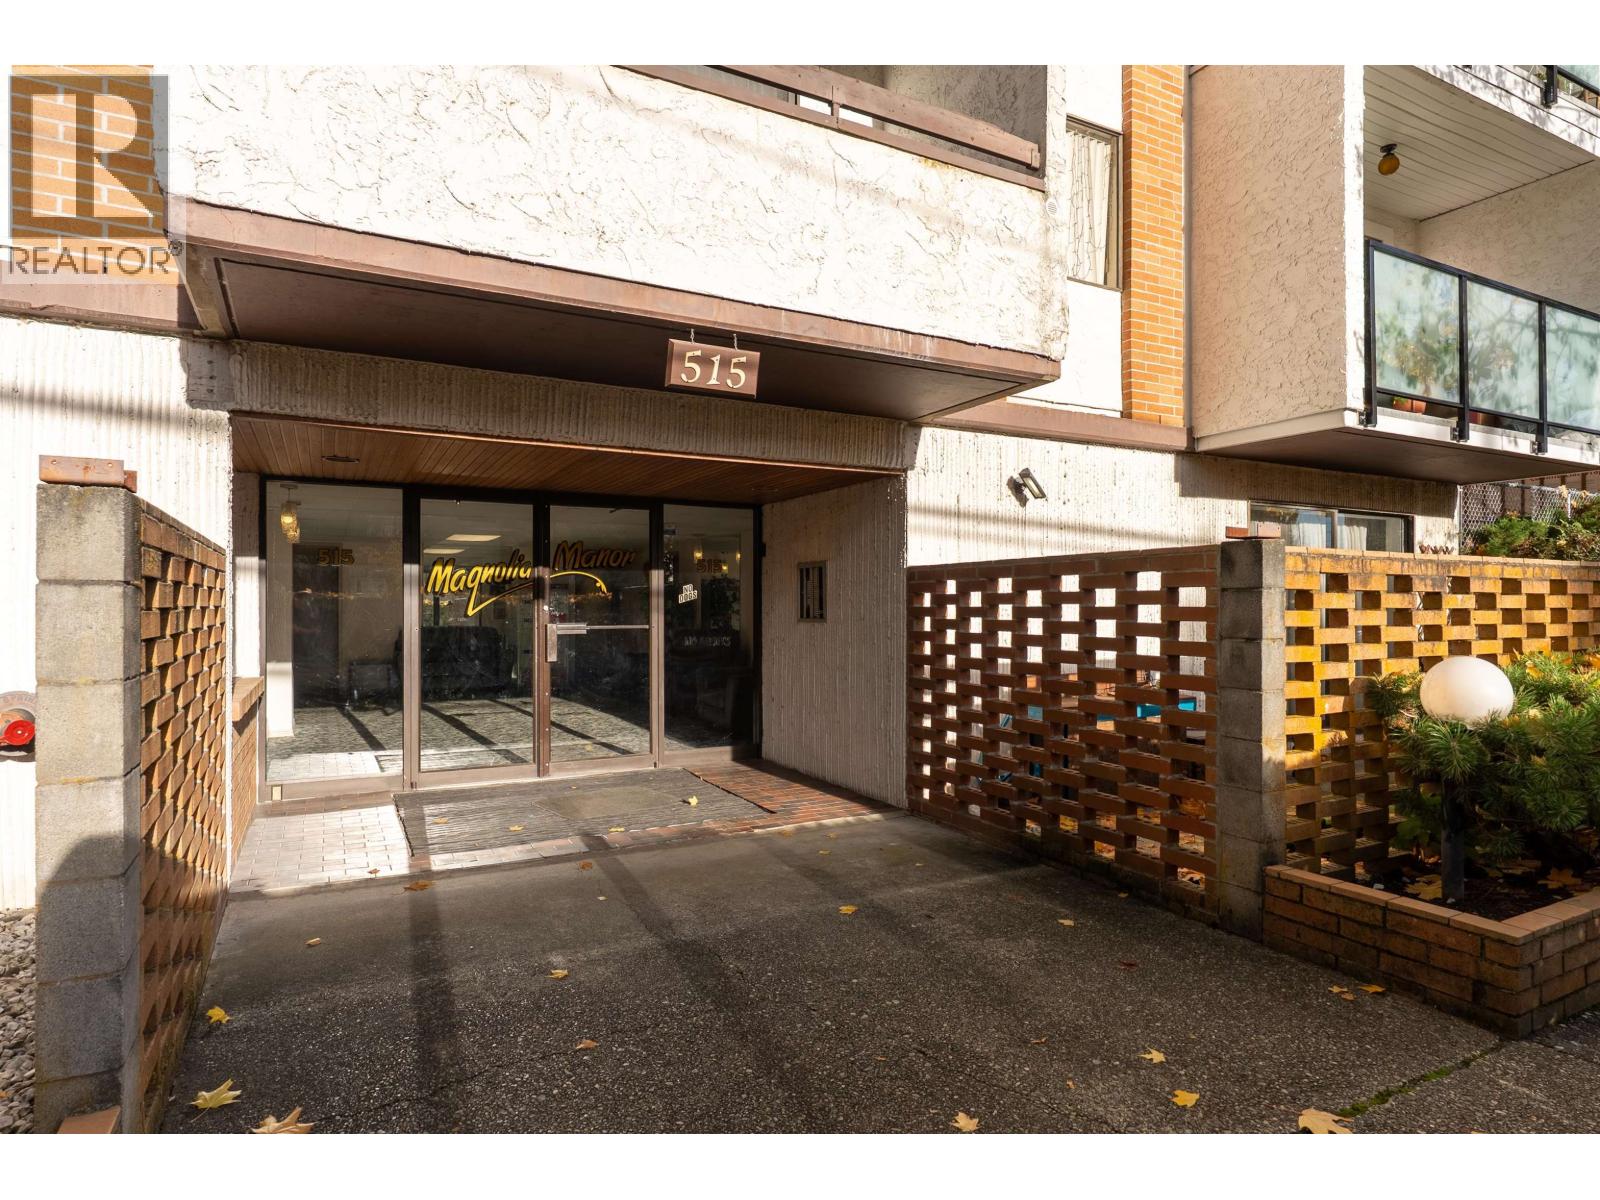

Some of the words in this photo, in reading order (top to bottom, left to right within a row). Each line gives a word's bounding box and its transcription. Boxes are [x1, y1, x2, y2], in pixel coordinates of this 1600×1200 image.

[680, 349, 747, 389] 515
[317, 547, 355, 566] 515
[425, 548, 533, 618] Magnolia
[553, 540, 638, 570] Manor
[679, 591, 697, 603] DOGS
[683, 584, 694, 594] NO
